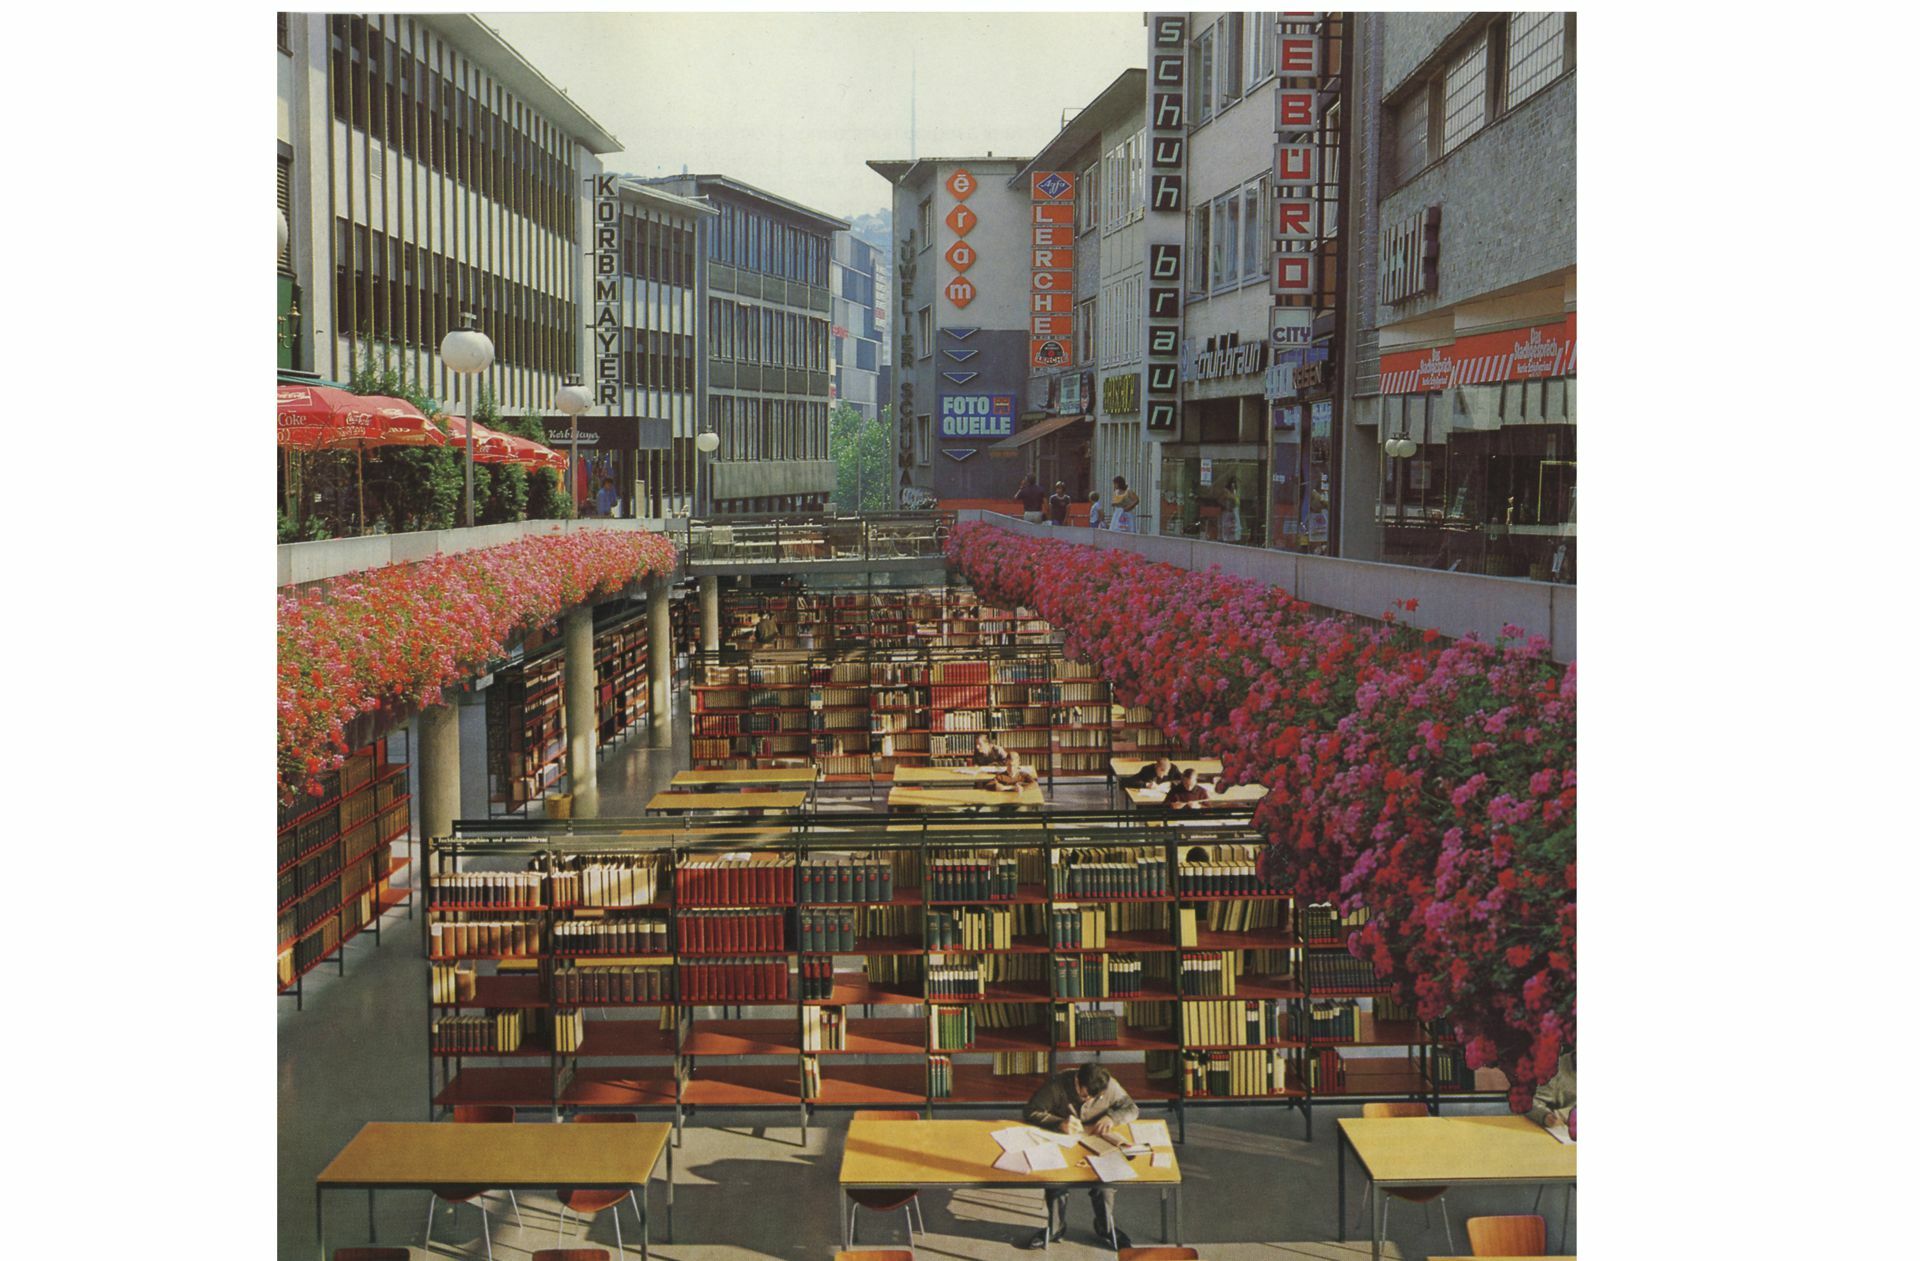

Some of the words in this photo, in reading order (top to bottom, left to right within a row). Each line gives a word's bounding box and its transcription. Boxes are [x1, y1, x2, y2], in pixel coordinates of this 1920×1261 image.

[1155, 21, 1182, 208] schuh
[1278, 12, 1313, 289] EBÜRO
[597, 175, 618, 405] KORBMAYER
[1034, 206, 1054, 334] LERCHE
[1150, 246, 1177, 426] braun
[1272, 326, 1311, 343] CITY
[278, 412, 307, 427] Coke
[943, 396, 990, 415] FOTO
[943, 416, 1011, 435] QUELLE
